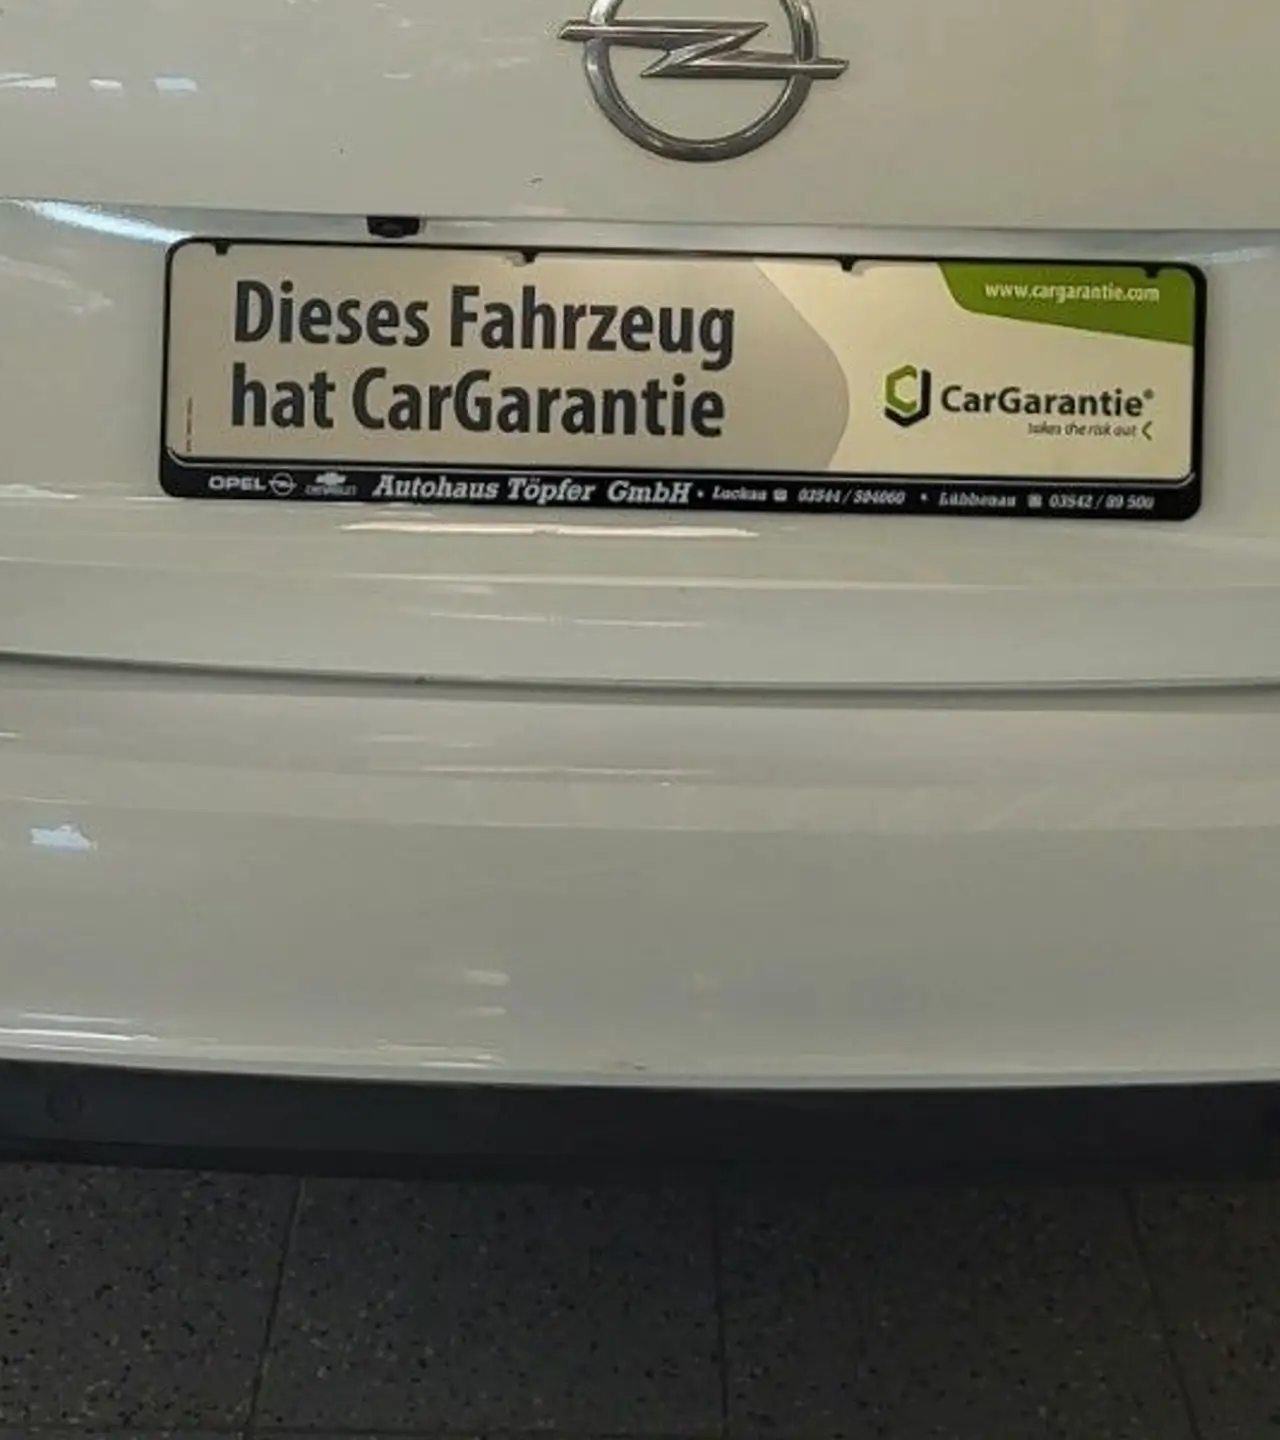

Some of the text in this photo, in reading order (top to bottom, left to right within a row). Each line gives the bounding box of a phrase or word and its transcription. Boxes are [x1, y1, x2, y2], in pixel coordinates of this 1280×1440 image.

[984, 281, 1160, 304] www.cargarantie.com
[233, 280, 735, 371] Dieses Fahrzeug
[231, 362, 336, 428] hat
[352, 366, 726, 437] CarGarantie
[1065, 421, 1085, 436] the
[1088, 422, 1111, 436] risk
[1113, 424, 1137, 437] out
[208, 474, 267, 491] OPEL
[372, 474, 500, 500] Autohaus
[507, 476, 595, 505] Töpfer
[607, 479, 690, 504] GmbH
